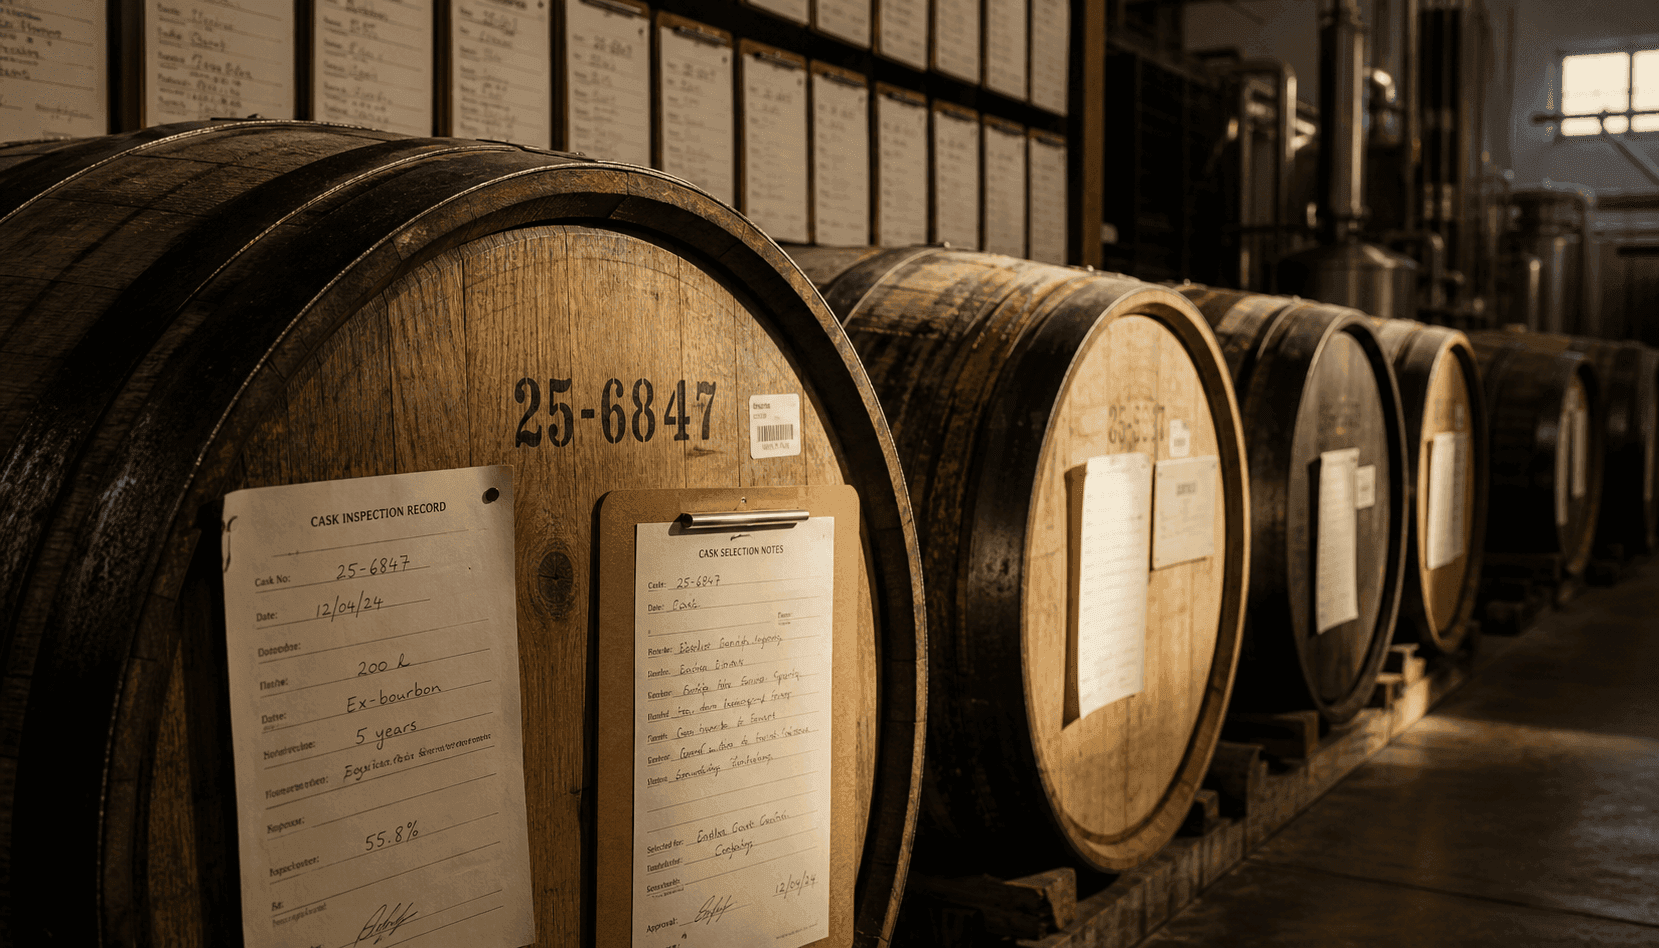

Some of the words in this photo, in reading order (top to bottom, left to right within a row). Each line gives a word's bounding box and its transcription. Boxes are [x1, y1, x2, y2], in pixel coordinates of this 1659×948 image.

[514, 377, 717, 448] 25-6847
[310, 513, 340, 528] CASK
[342, 506, 405, 524] INSPECTION
[407, 501, 447, 517] RECORD
[698, 548, 719, 559] CASK
[720, 546, 760, 558] SELECTION
[760, 544, 784, 555] NOTES
[254, 575, 274, 588] Cask
[276, 573, 292, 584] No:
[335, 554, 411, 581] 25-6847
[676, 574, 721, 589] 25-6847
[256, 610, 279, 623] Date:
[316, 590, 384, 623] 12/04/24
[357, 661, 388, 677] 200
[345, 682, 442, 714] Ex-bourbon
[354, 728, 369, 745] 5
[375, 720, 418, 750] years
[364, 820, 420, 851] 55.8%
[646, 840, 673, 855] Selected
[775, 870, 817, 900] 12/04/24
[646, 917, 679, 935] Approval:
